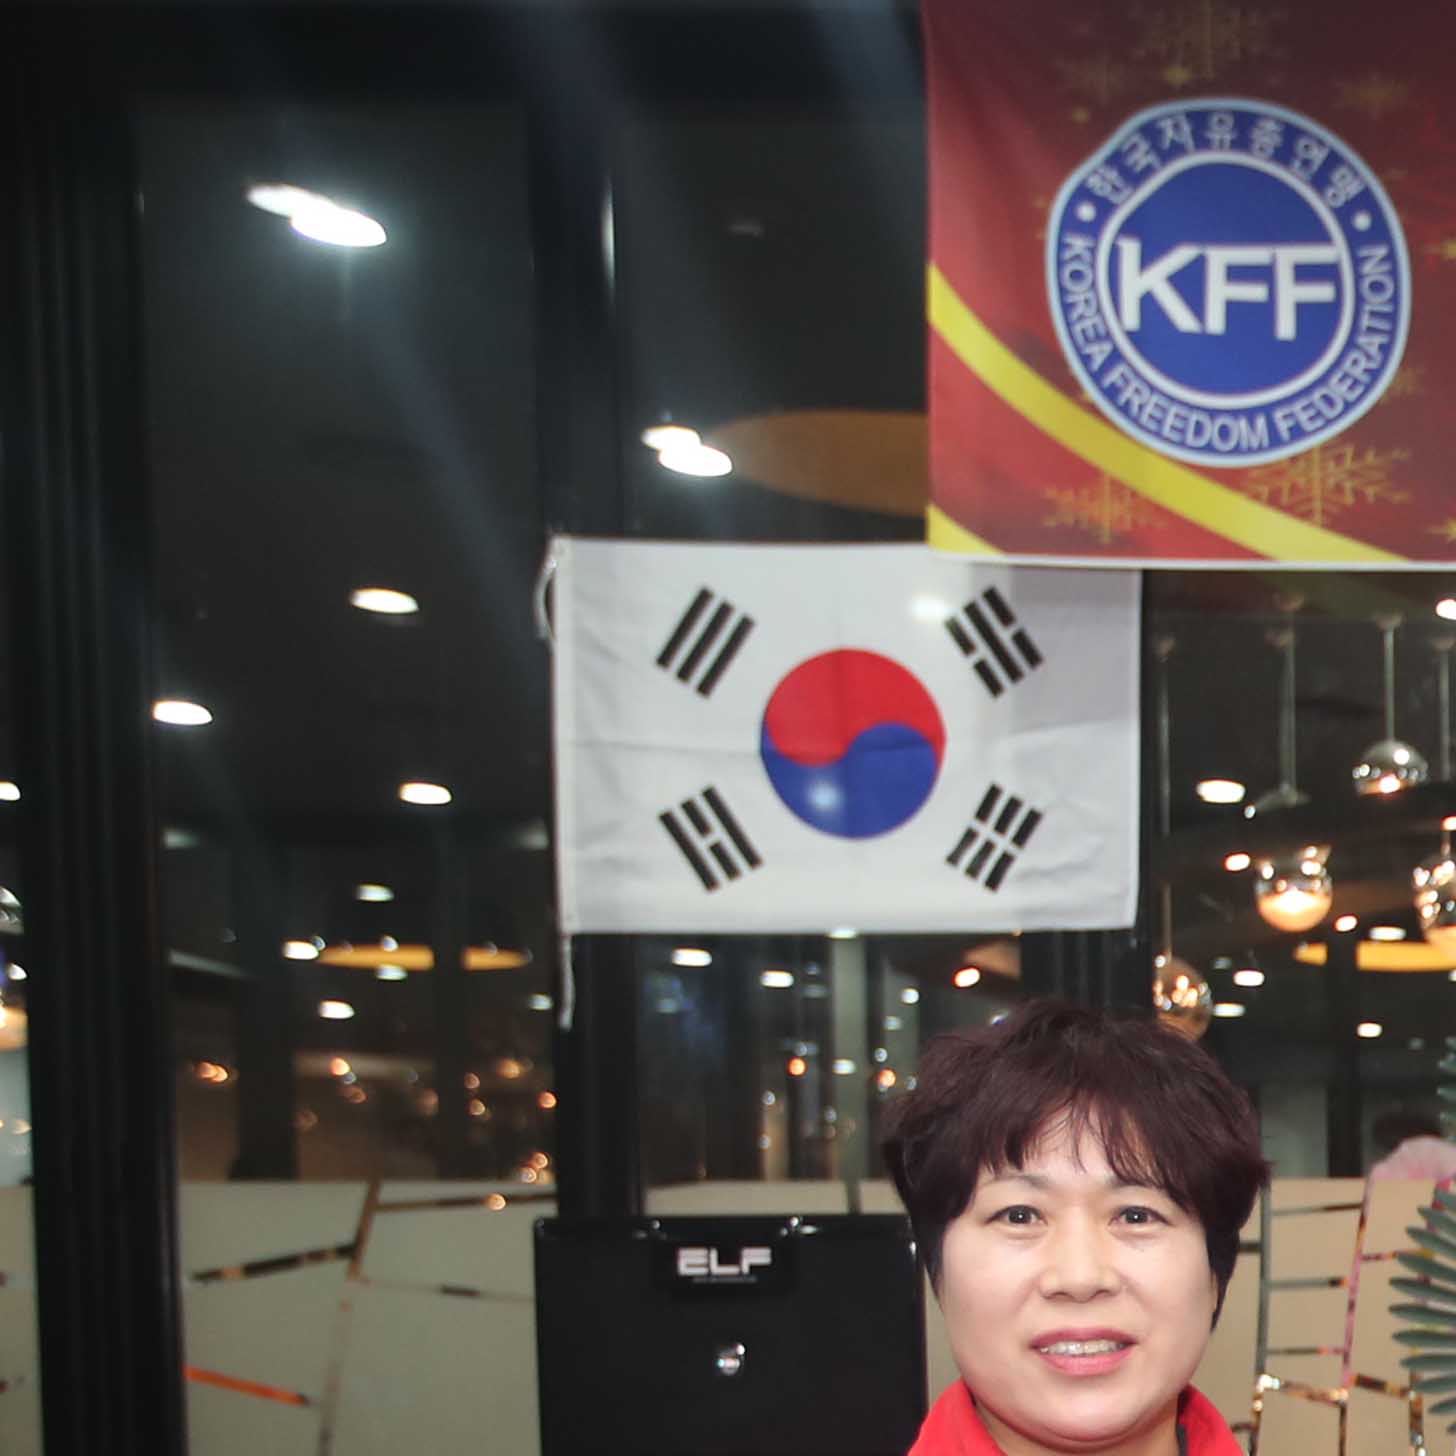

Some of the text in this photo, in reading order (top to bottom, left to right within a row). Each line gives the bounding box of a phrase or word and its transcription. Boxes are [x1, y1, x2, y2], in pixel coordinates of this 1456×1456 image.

[1060, 231, 1395, 452] KOREA FREEDOM FEDERATION
[1115, 235, 1340, 342] KFF
[677, 1247, 772, 1276] ELF
